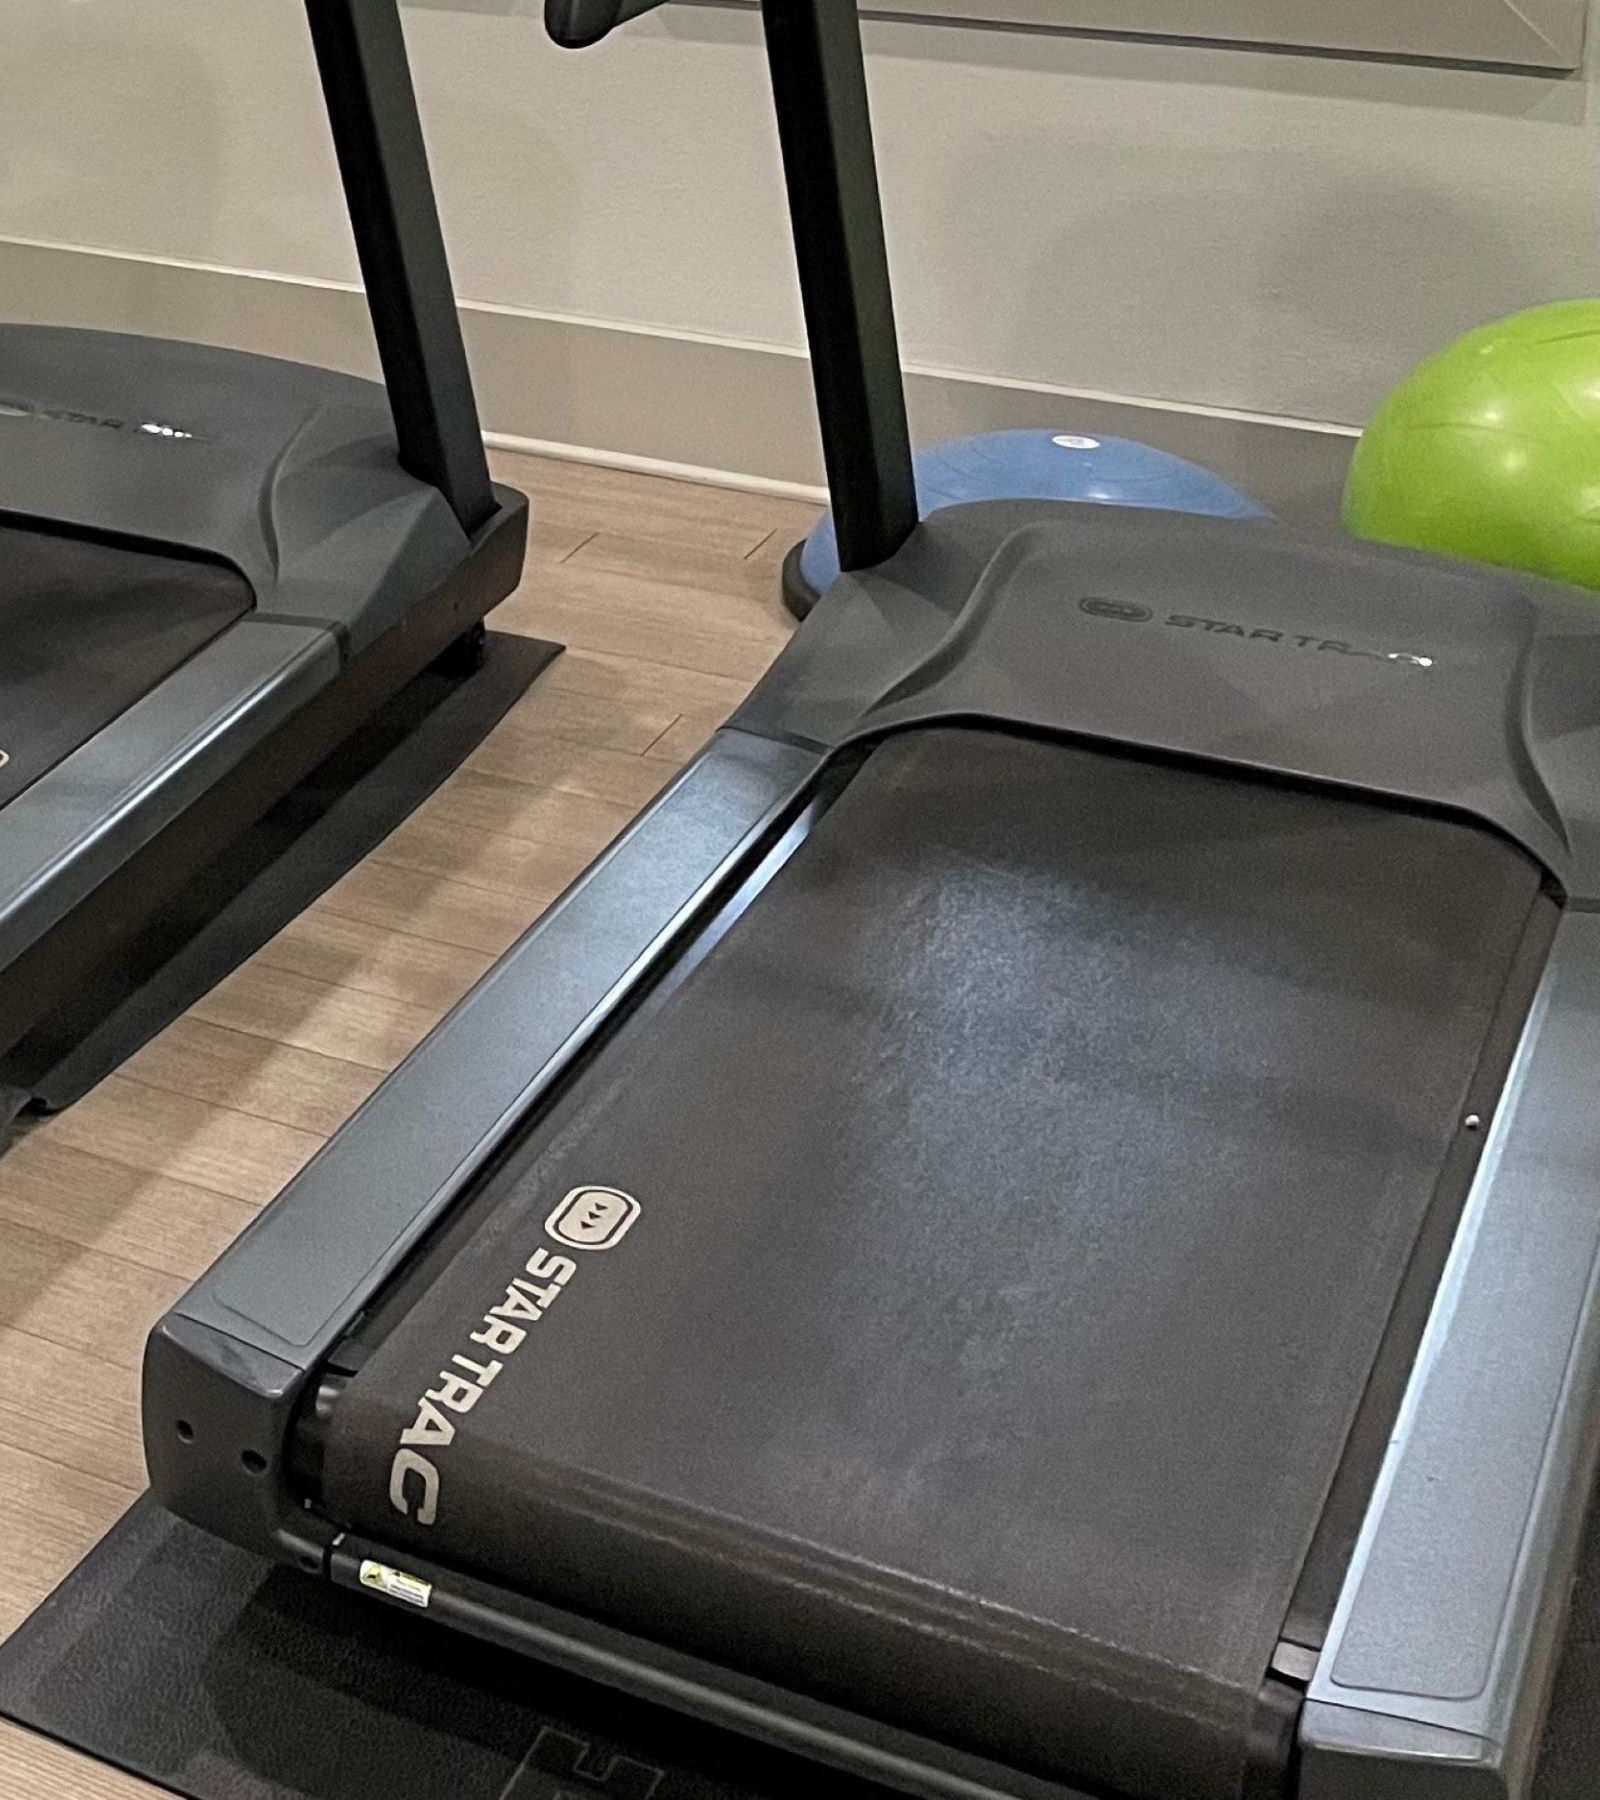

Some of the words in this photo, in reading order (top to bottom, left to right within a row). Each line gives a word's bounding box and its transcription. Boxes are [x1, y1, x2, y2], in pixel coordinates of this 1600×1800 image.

[1164, 614, 1283, 643] STAR
[1294, 633, 1434, 668] TR
[469, 1247, 577, 1355] STAR
[389, 1354, 504, 1526] TRAC
